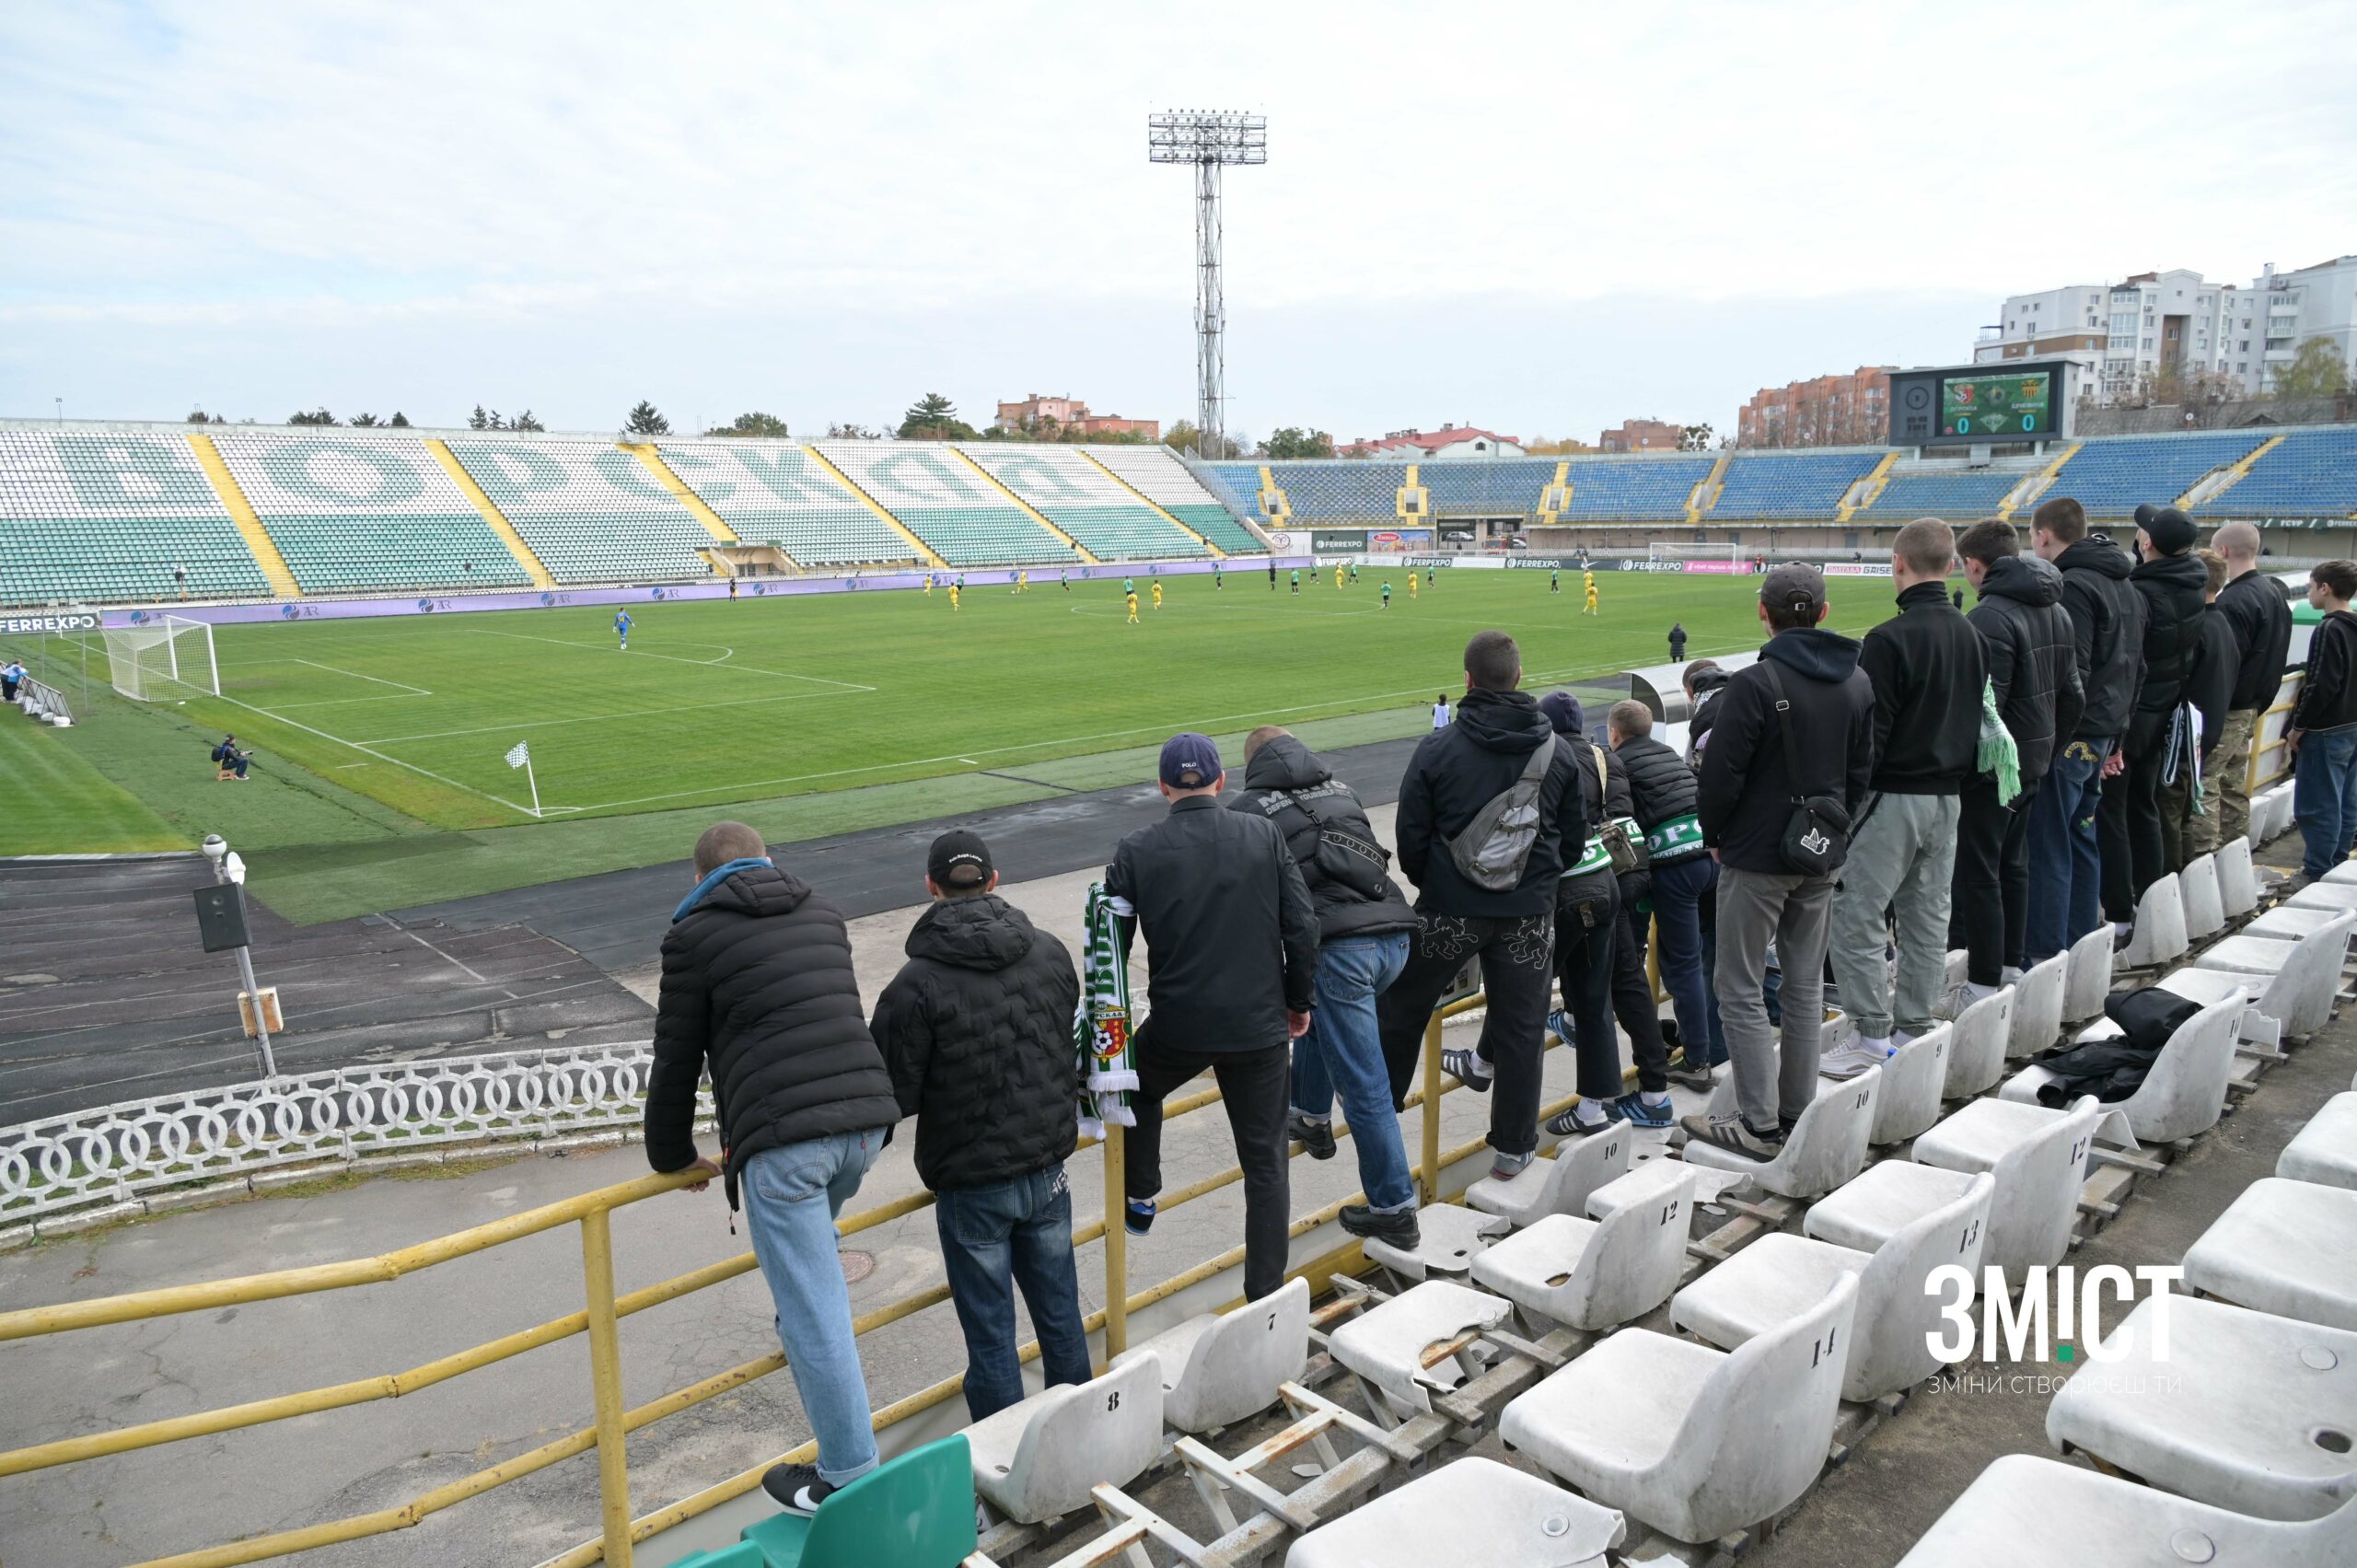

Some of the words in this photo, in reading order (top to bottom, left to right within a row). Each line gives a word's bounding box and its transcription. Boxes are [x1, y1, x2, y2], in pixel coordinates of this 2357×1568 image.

[1957, 417, 1969, 435] 0
[2022, 413, 2035, 432] 0
[1516, 559, 1560, 569] FERREXPO
[1633, 561, 1682, 571] FERREXPO
[0, 615, 96, 633] FERREXPO
[1265, 797, 1295, 816] DEFEN
[2000, 1005, 2007, 1020] 8
[1935, 1043, 1943, 1058] 9
[1855, 1088, 1870, 1109] 10
[1604, 1142, 1618, 1161] 10
[1660, 1200, 1678, 1226] 12
[1959, 1219, 1980, 1254] 13
[1267, 1312, 1277, 1330] 7
[1108, 1391, 1120, 1411] 8
